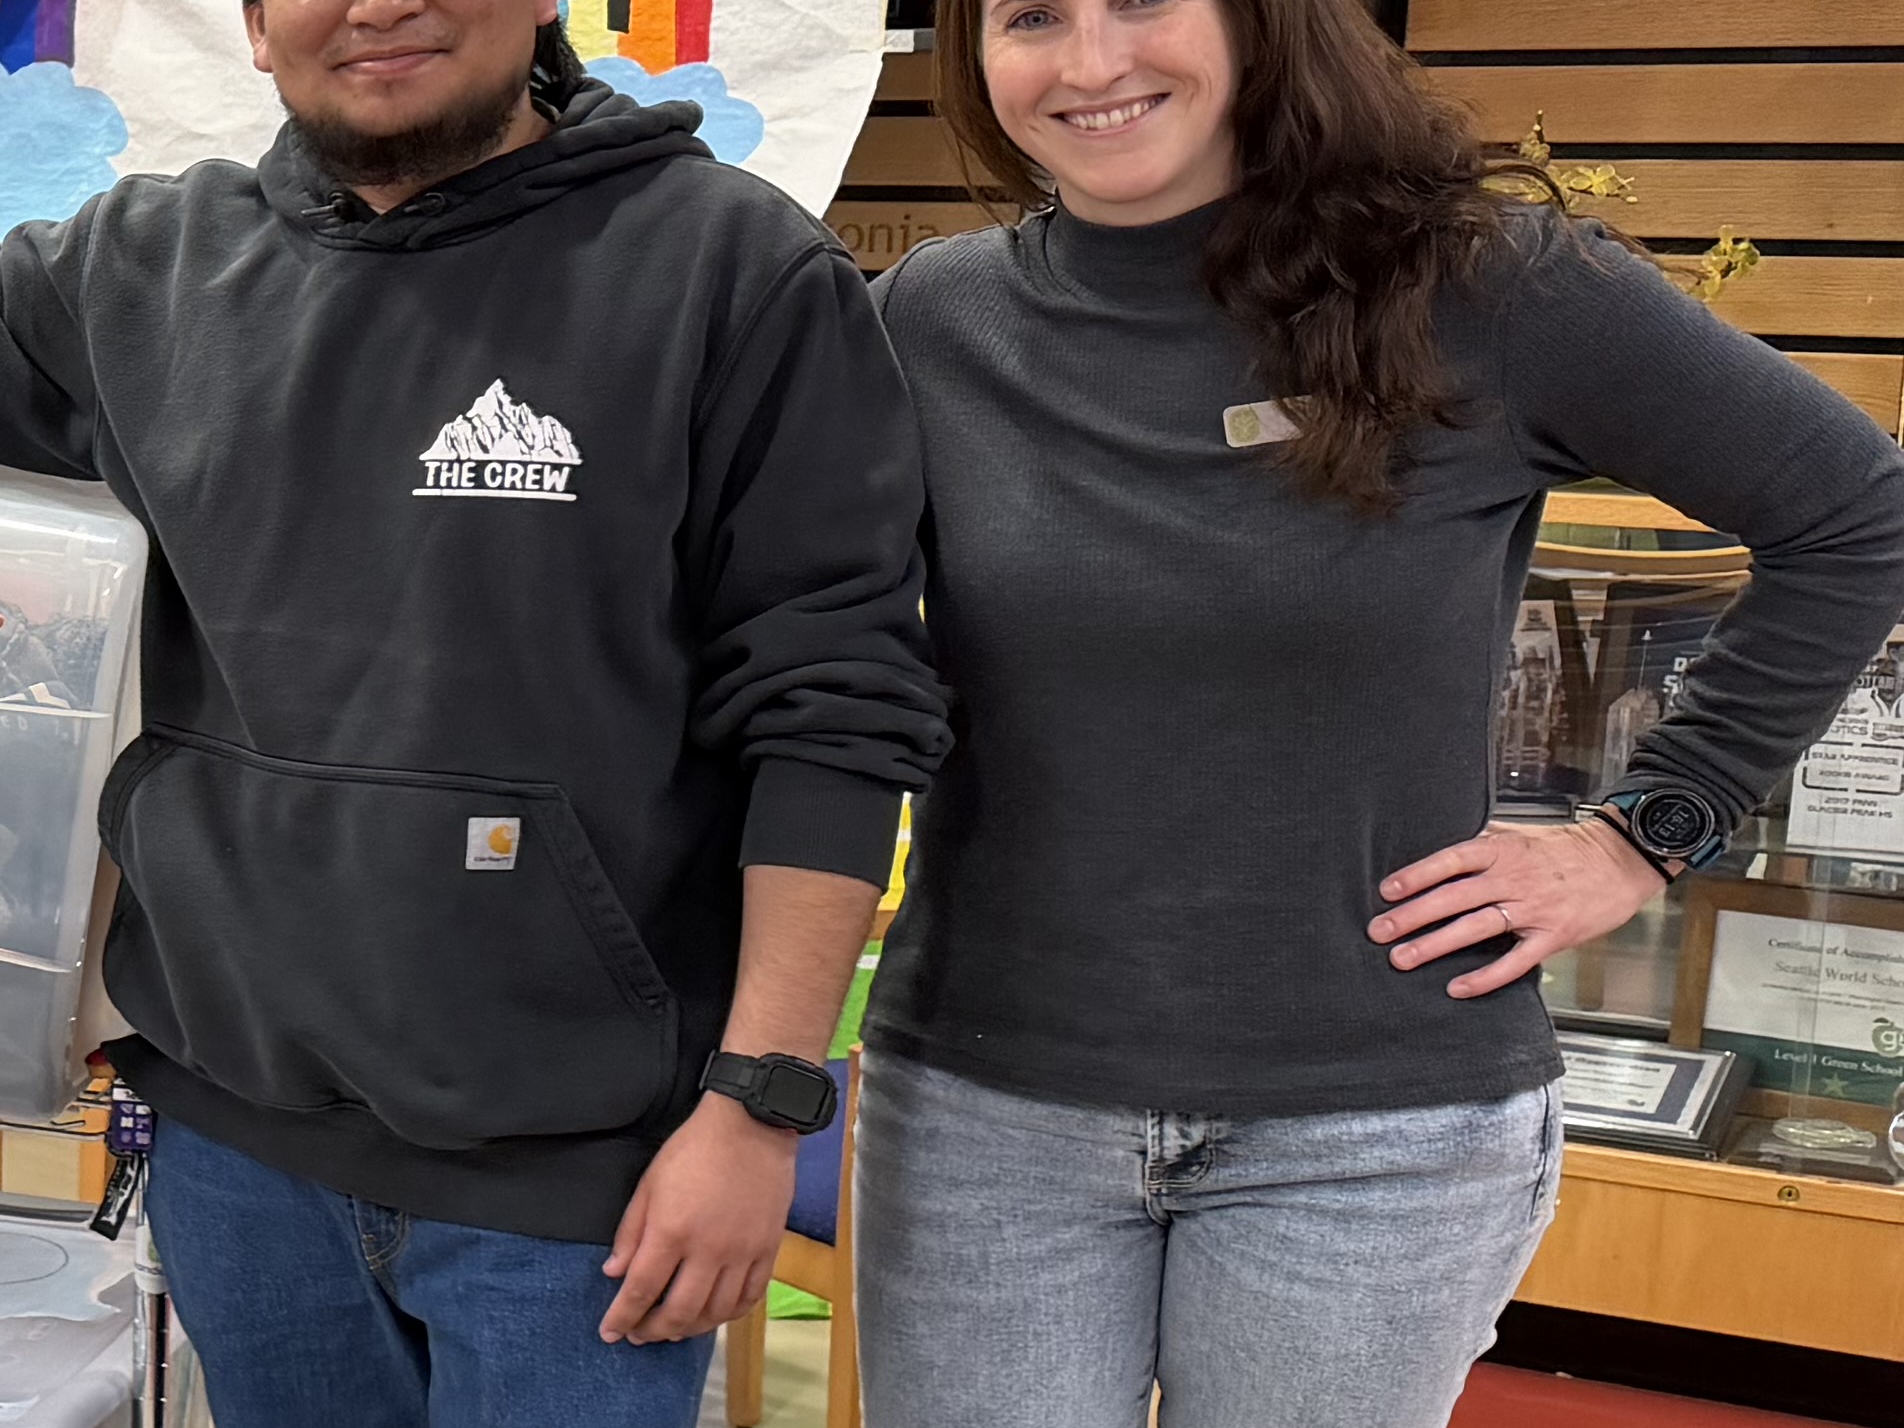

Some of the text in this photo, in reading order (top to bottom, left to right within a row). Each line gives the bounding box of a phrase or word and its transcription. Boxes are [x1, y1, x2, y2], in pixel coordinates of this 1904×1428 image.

[424, 461, 571, 493] THE CREW
[1825, 967, 1868, 985] World
[1820, 1055, 1859, 1072] Green
[1860, 1059, 1904, 1079] School
